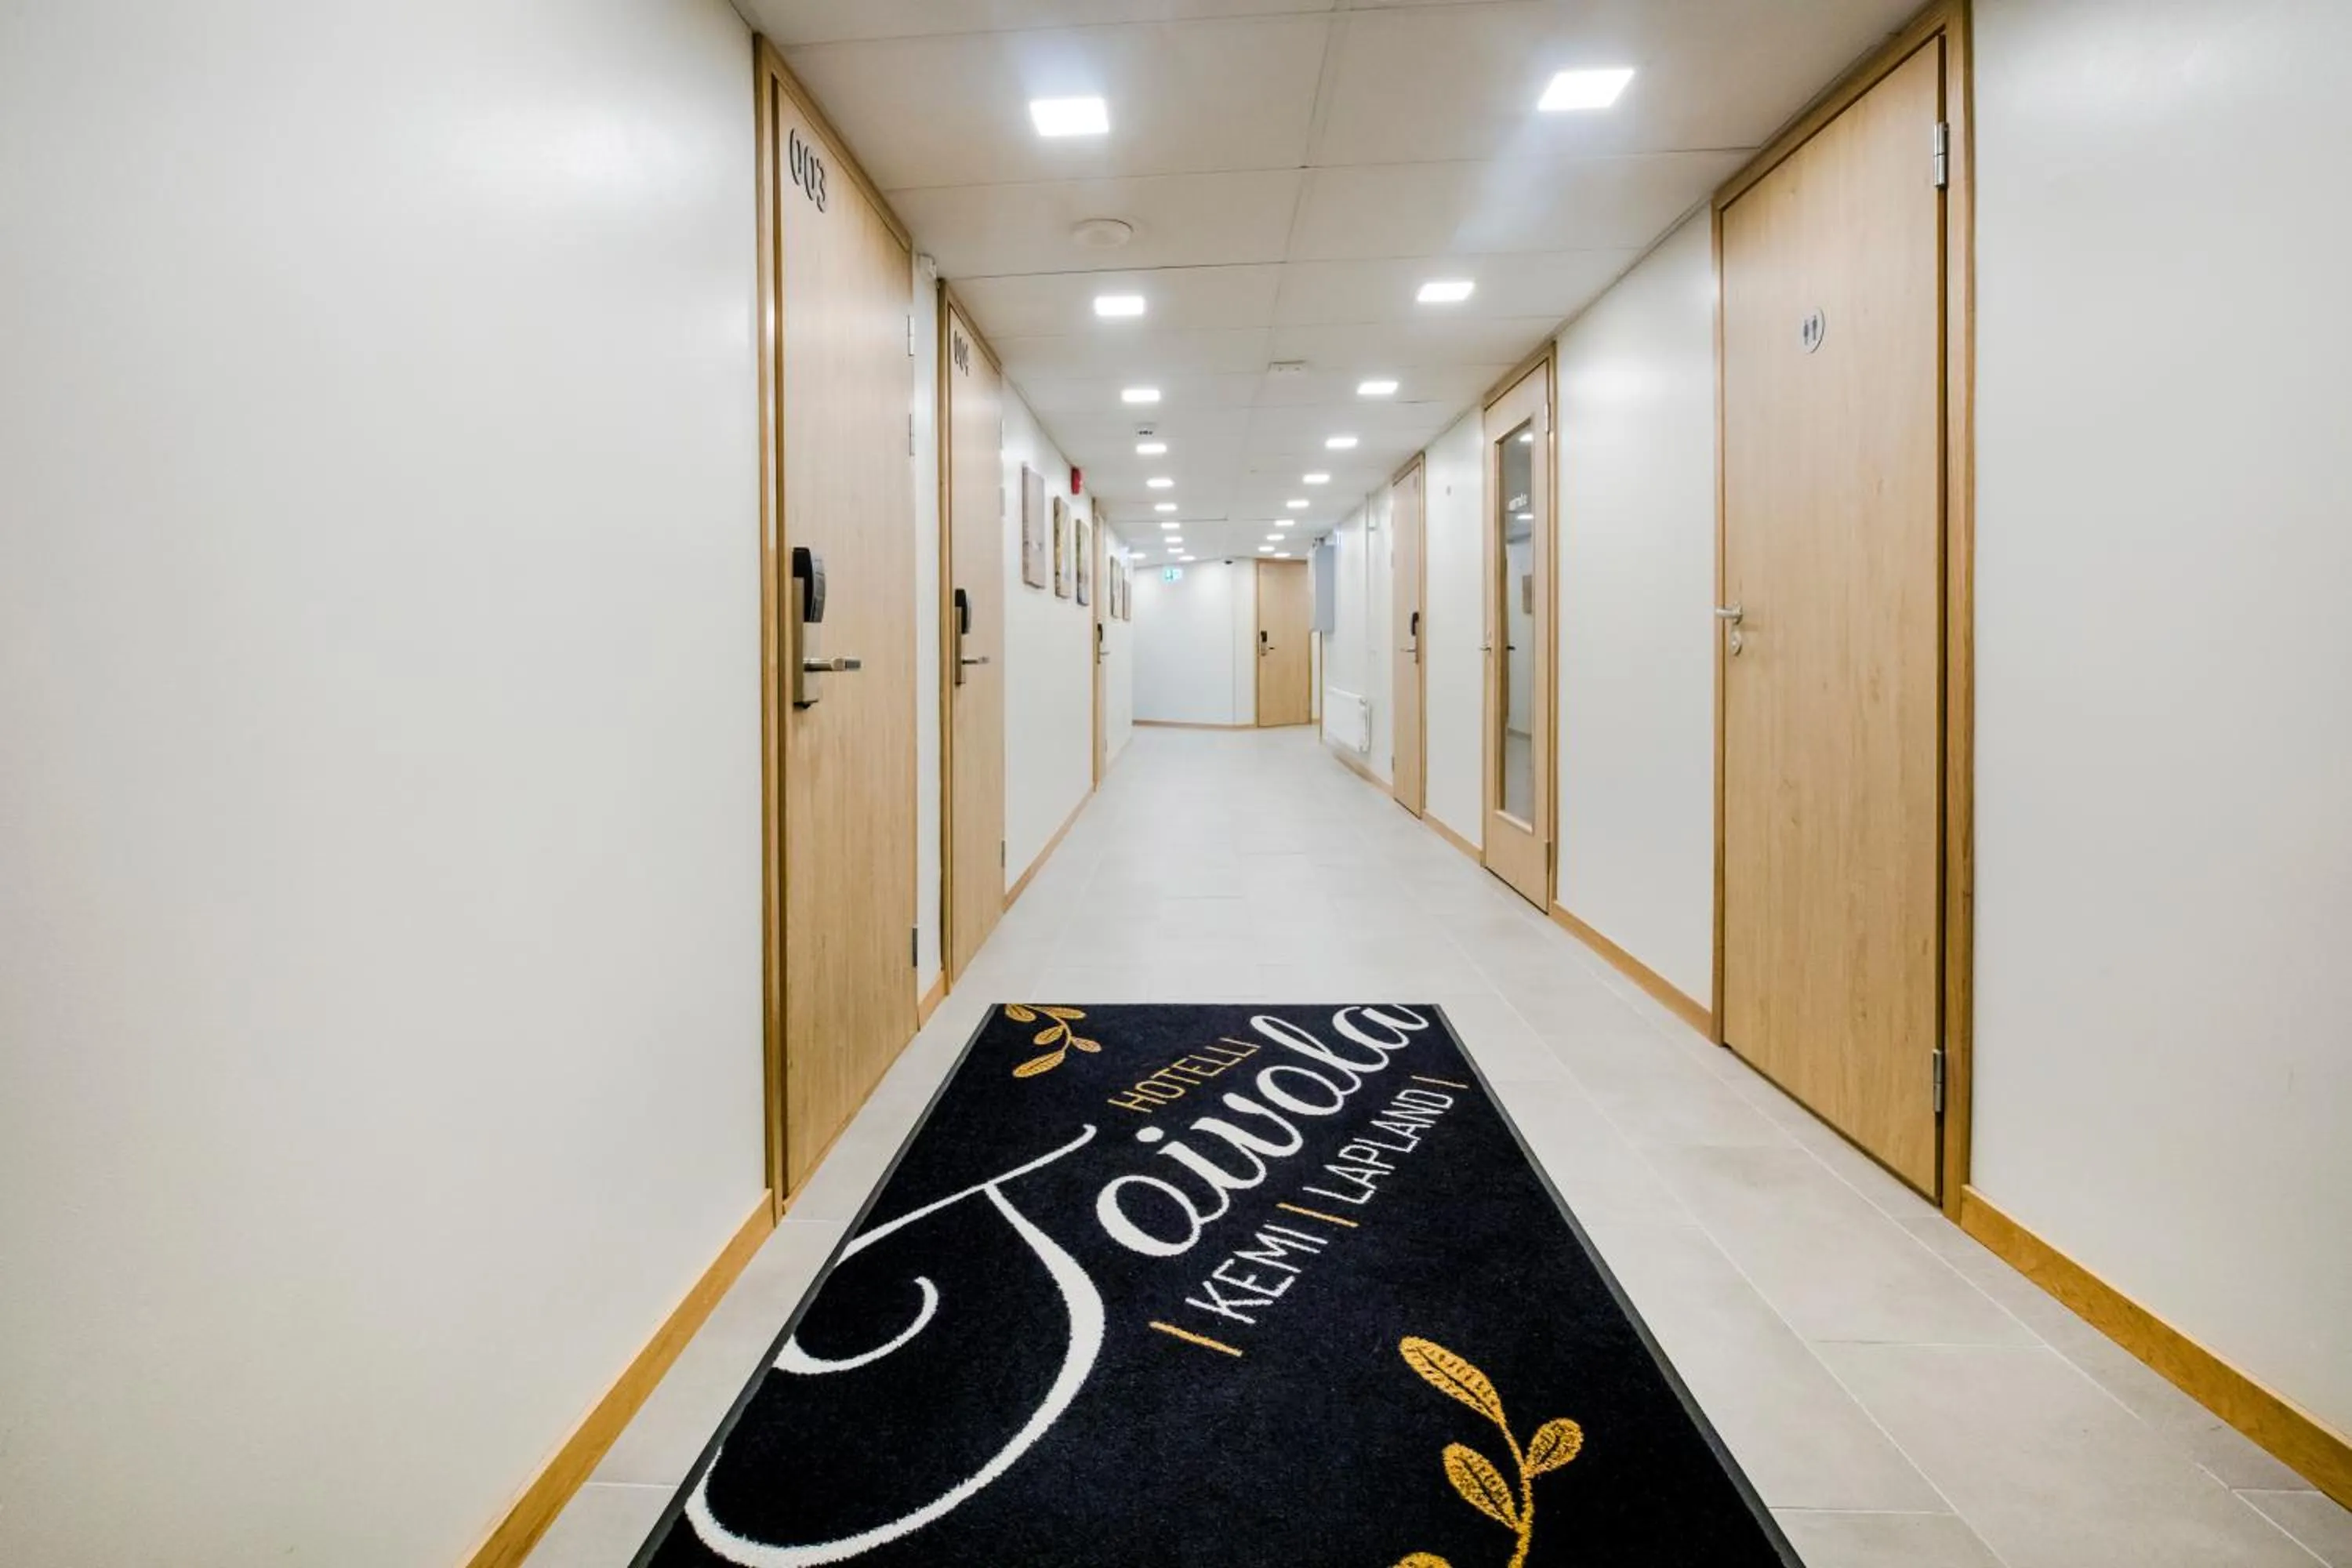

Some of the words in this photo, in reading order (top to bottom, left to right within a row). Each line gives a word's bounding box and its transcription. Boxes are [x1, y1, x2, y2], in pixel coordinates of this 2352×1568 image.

[789, 128, 826, 213] 003
[1107, 1037, 1261, 1112] HOTELLI
[684, 1004, 1428, 1567] Toivola
[1185, 1223, 1328, 1323] KEMI
[1302, 1089, 1454, 1205] LAPLAND
